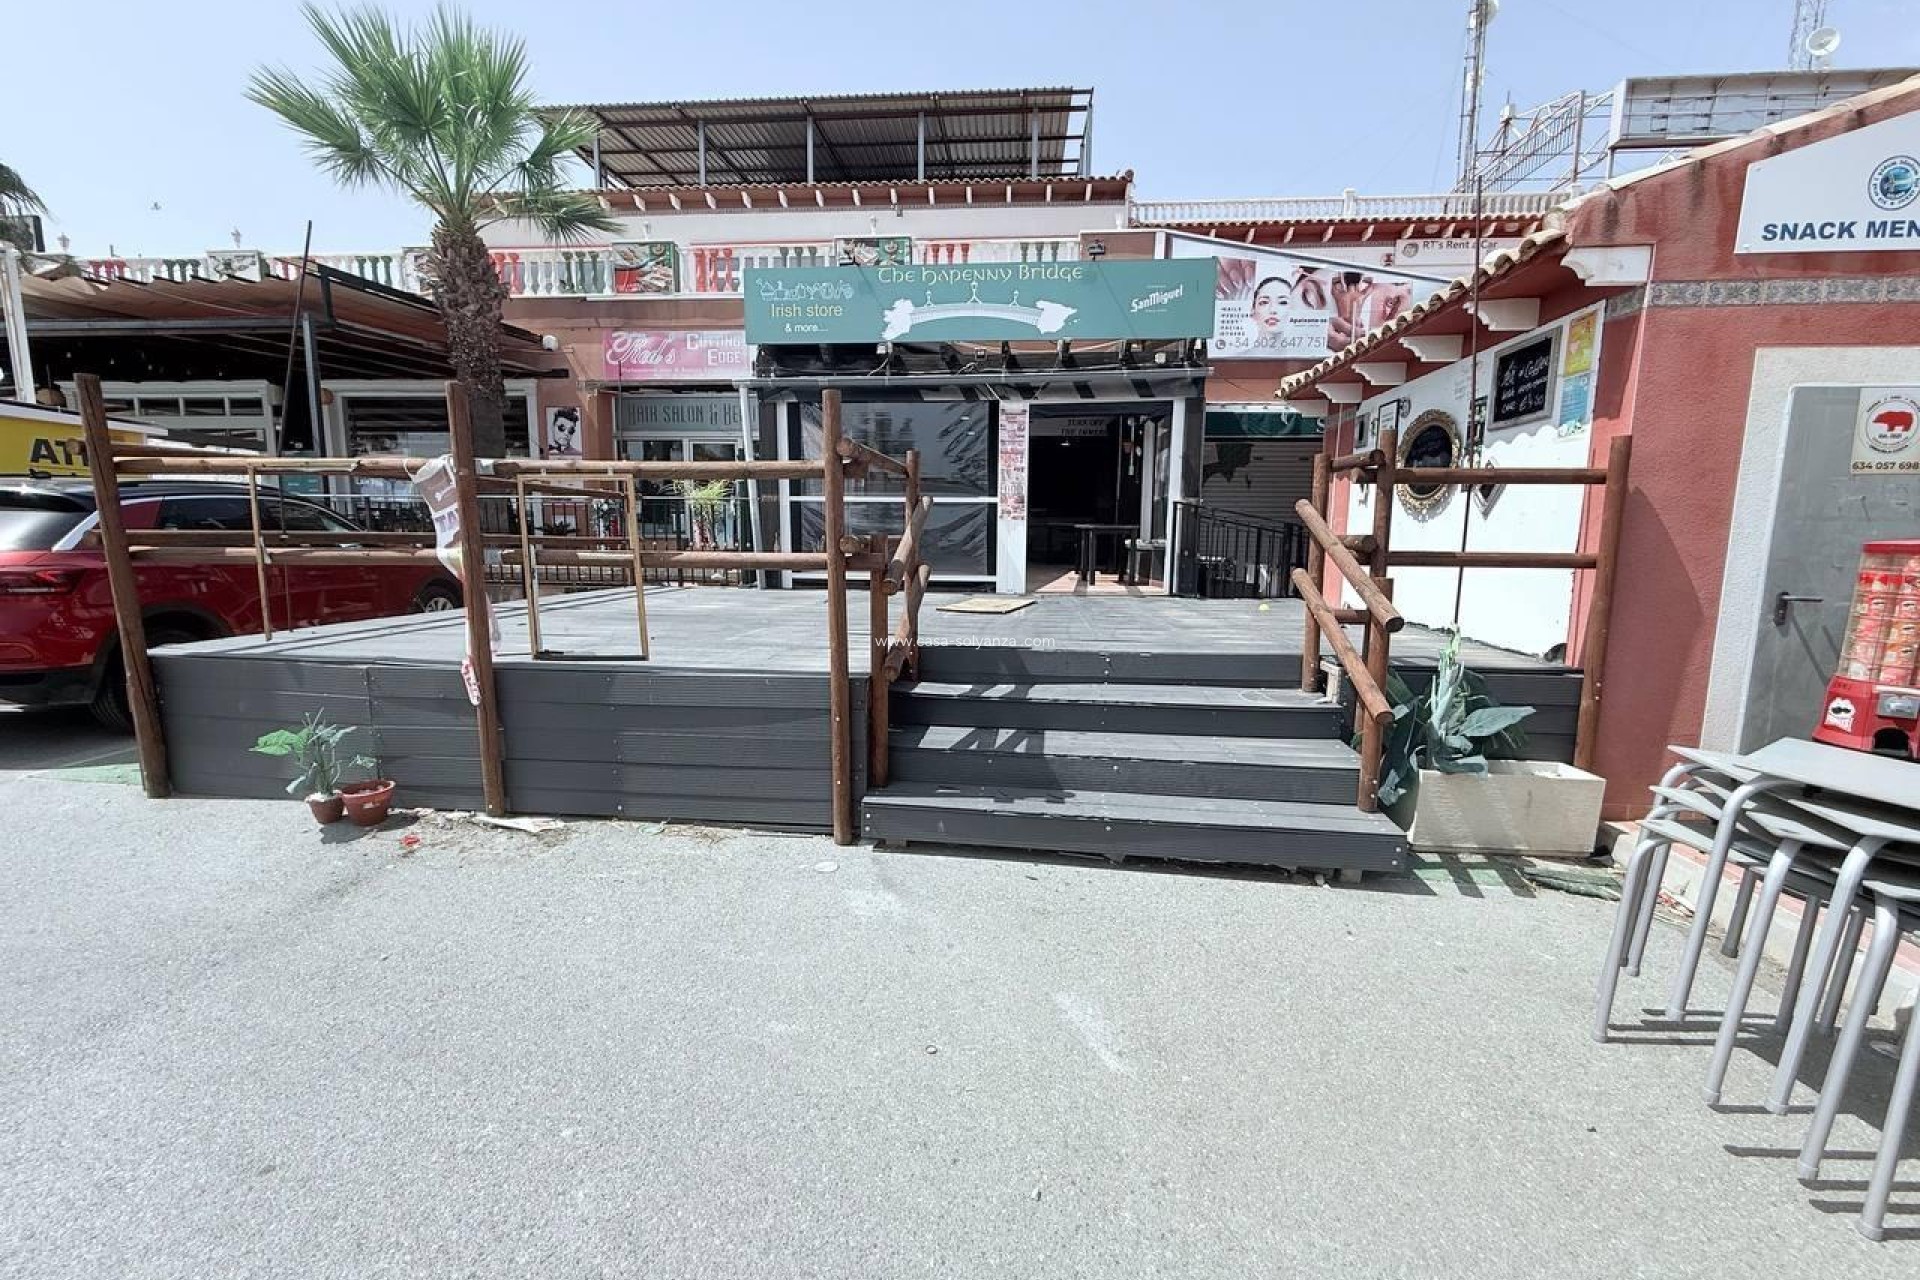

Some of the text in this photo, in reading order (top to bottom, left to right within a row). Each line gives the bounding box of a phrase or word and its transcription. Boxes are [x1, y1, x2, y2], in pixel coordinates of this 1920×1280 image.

[1761, 220, 1858, 242] SNACK
[1422, 240, 1444, 250] RT's
[1446, 240, 1470, 250] Rent
[877, 267, 915, 284] The
[1018, 264, 1084, 282] Bridge
[771, 303, 844, 318] Irish store
[784, 322, 793, 333] &
[1253, 337, 1277, 348] 602
[1280, 337, 1302, 348] 647
[1852, 461, 1873, 470] 634
[1875, 461, 1896, 470] 057
